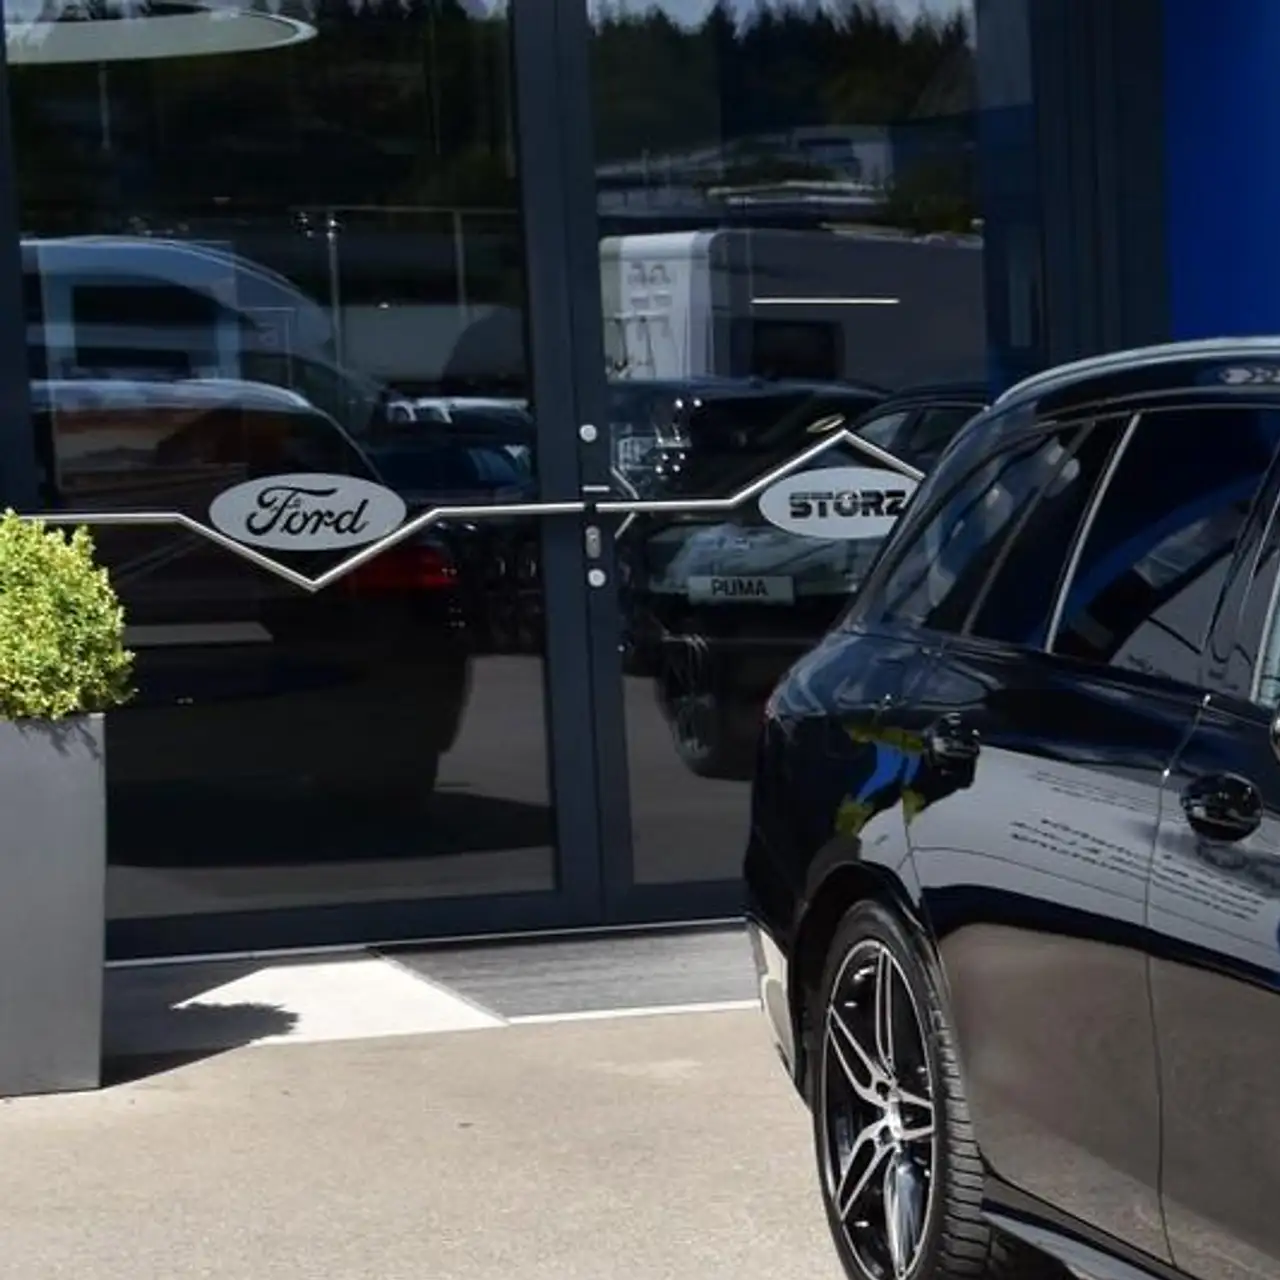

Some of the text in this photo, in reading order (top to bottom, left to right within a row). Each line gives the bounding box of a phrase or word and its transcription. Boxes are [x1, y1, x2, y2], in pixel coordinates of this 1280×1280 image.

[246, 486, 370, 536] Ford
[789, 489, 906, 518] STORZ
[711, 578, 769, 597] PUMA
